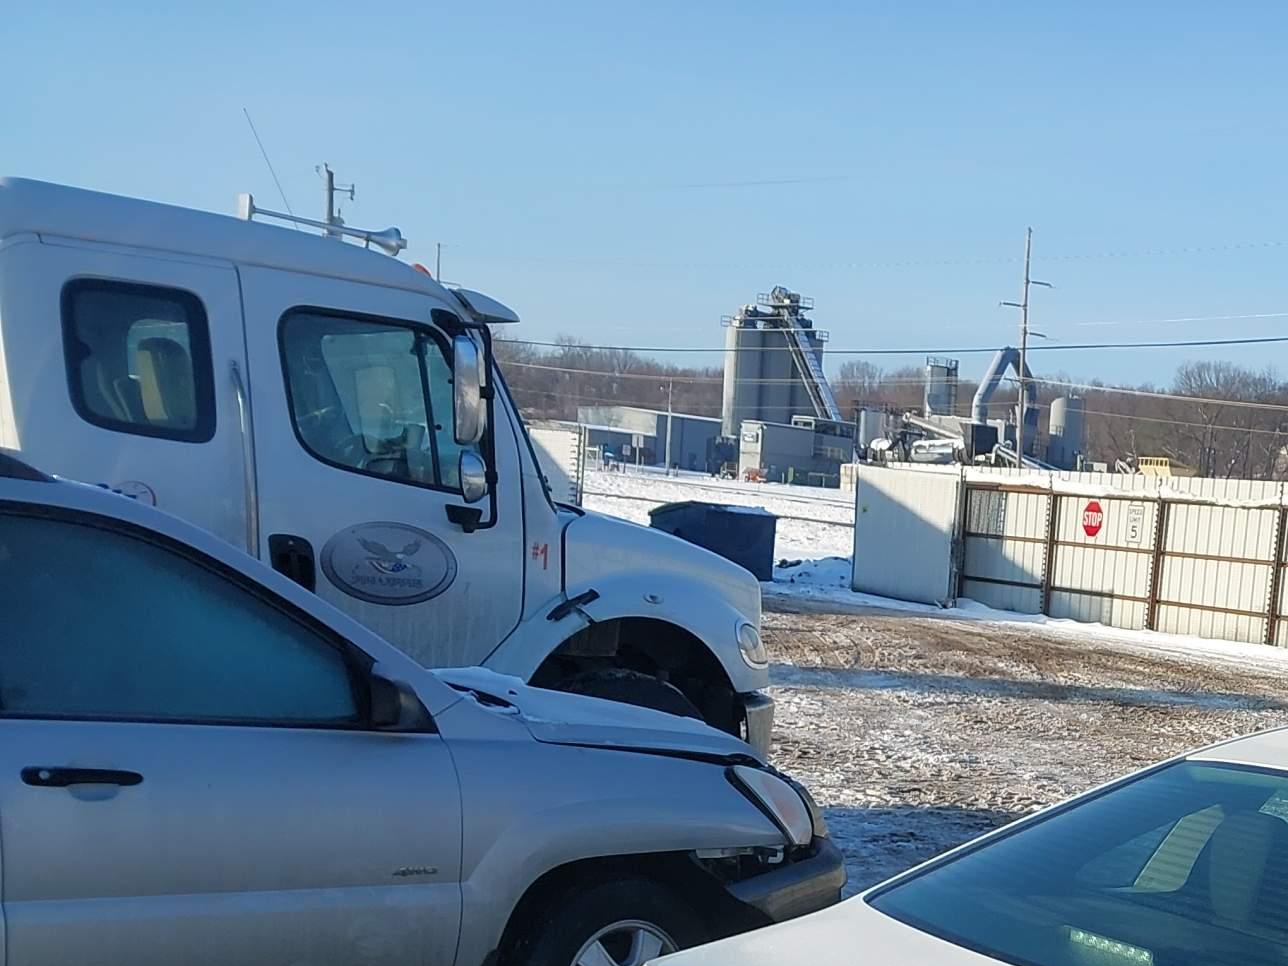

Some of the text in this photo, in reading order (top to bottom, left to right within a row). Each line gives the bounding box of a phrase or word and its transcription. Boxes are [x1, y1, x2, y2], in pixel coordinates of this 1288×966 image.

[1083, 511, 1103, 527] STOP
[1130, 525, 1138, 539] 5
[532, 542, 549, 570] #1
